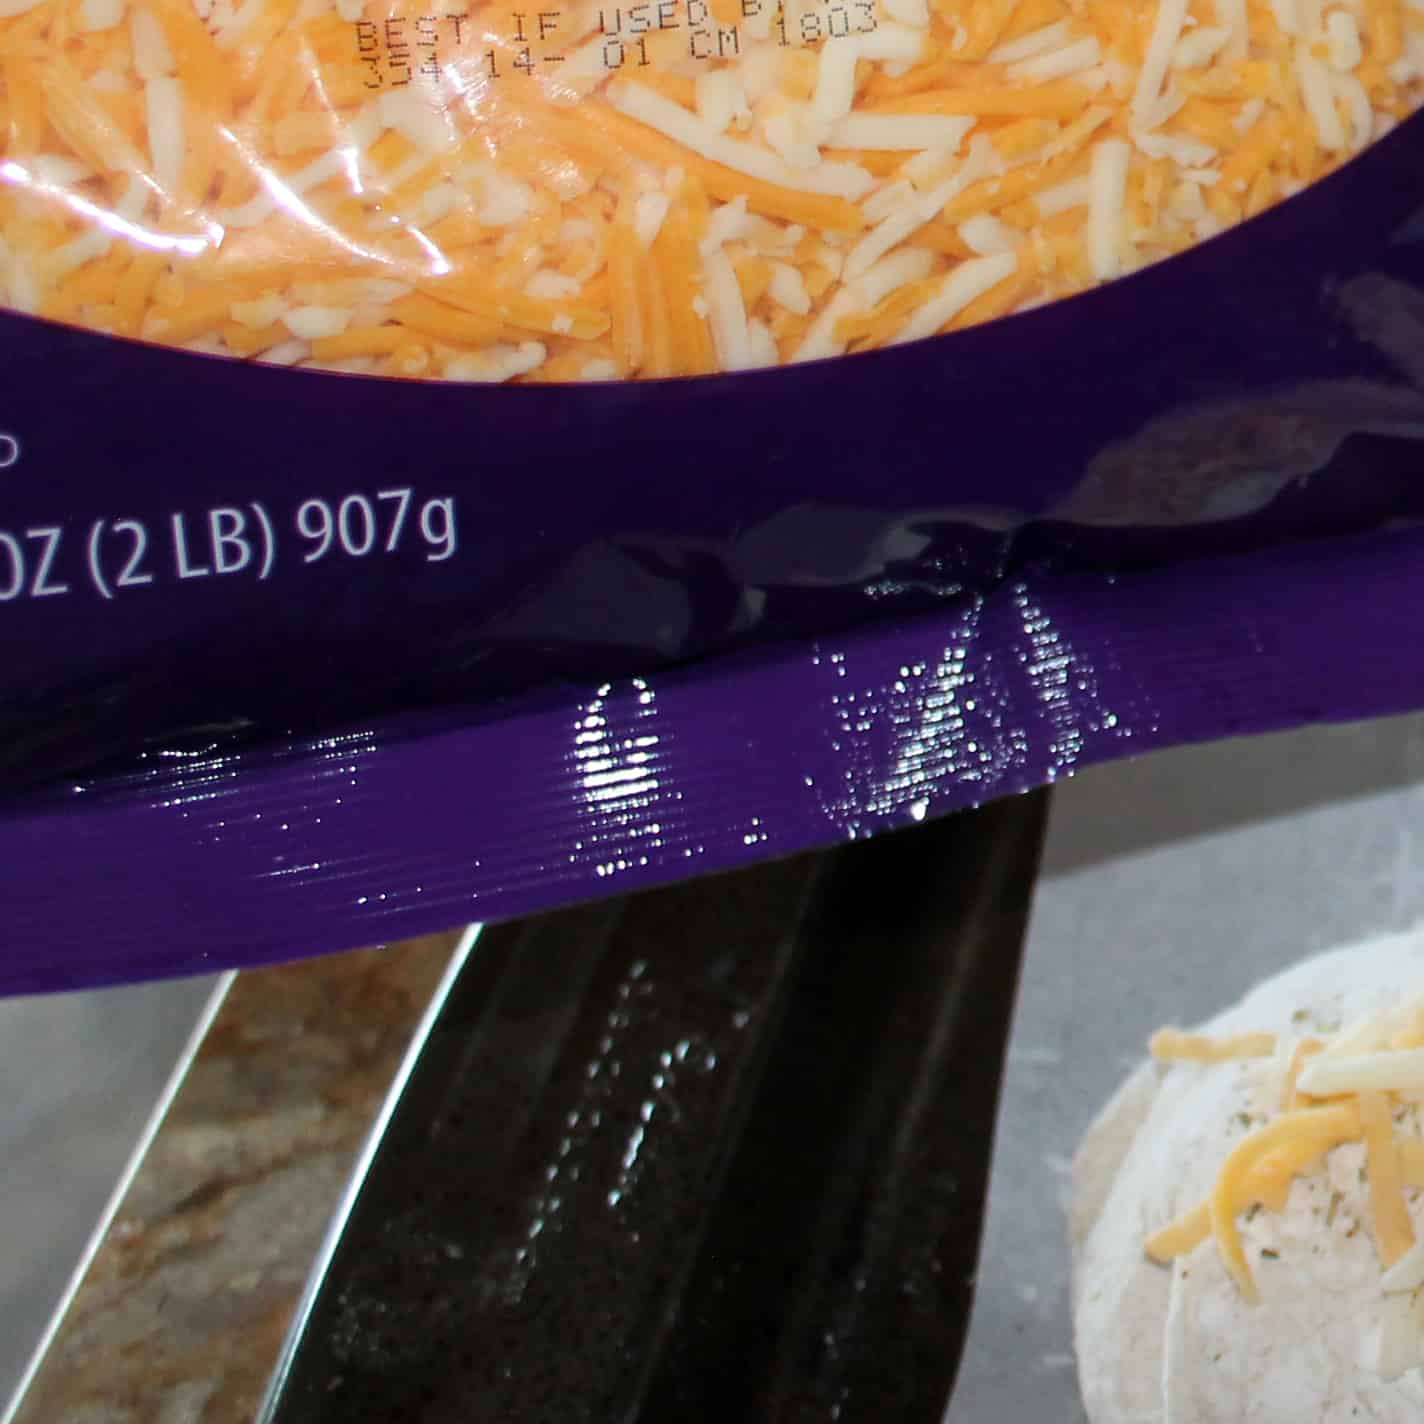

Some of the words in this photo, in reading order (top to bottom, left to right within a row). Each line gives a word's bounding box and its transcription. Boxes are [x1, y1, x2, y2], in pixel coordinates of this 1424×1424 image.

[356, 13, 468, 52] BEST
[513, 12, 560, 42] IF
[690, 26, 739, 59] CM
[776, 0, 878, 47] 1803
[89, 519, 153, 599] (2
[172, 502, 274, 579] LB)
[298, 488, 458, 563] 907g
